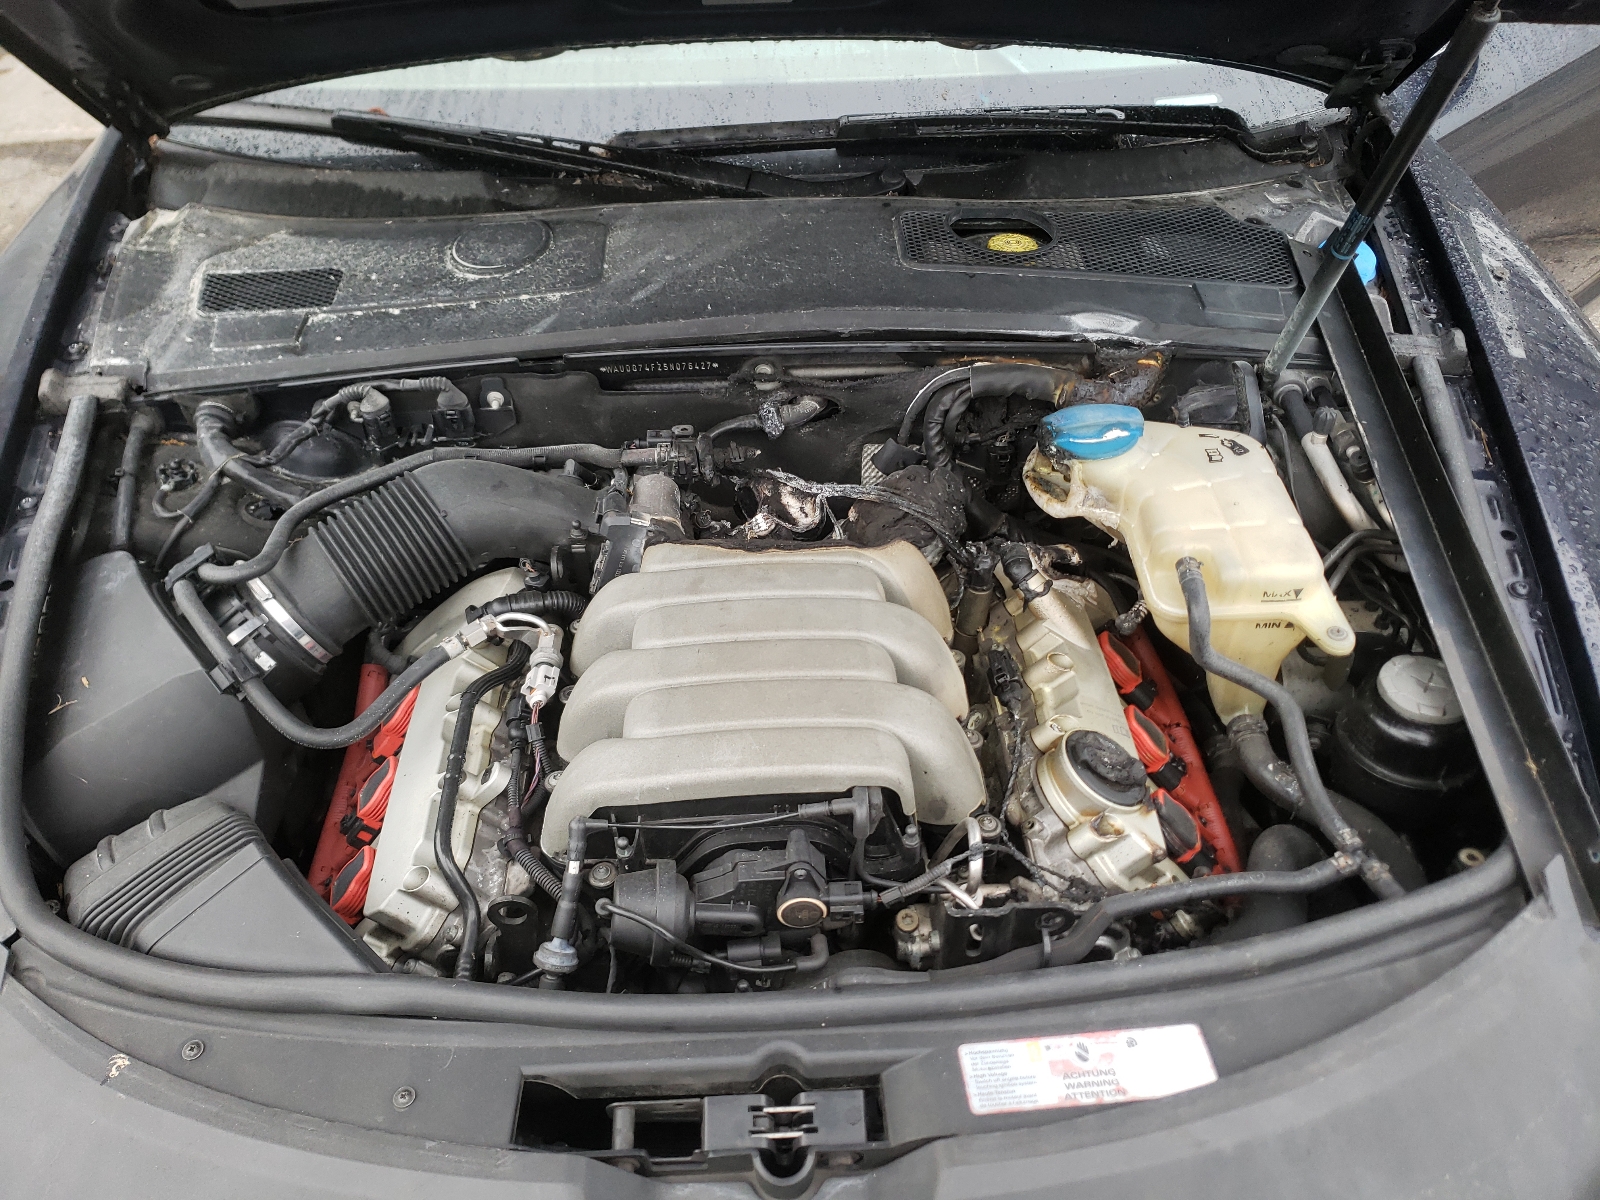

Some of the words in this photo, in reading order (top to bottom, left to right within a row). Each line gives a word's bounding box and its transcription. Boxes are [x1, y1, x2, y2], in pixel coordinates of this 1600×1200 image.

[1255, 621, 1282, 629] MIN
[1063, 1067, 1117, 1081] ACHTUNG
[1064, 1078, 1120, 1091] WARNING
[1064, 1088, 1127, 1101] ATTENTION
